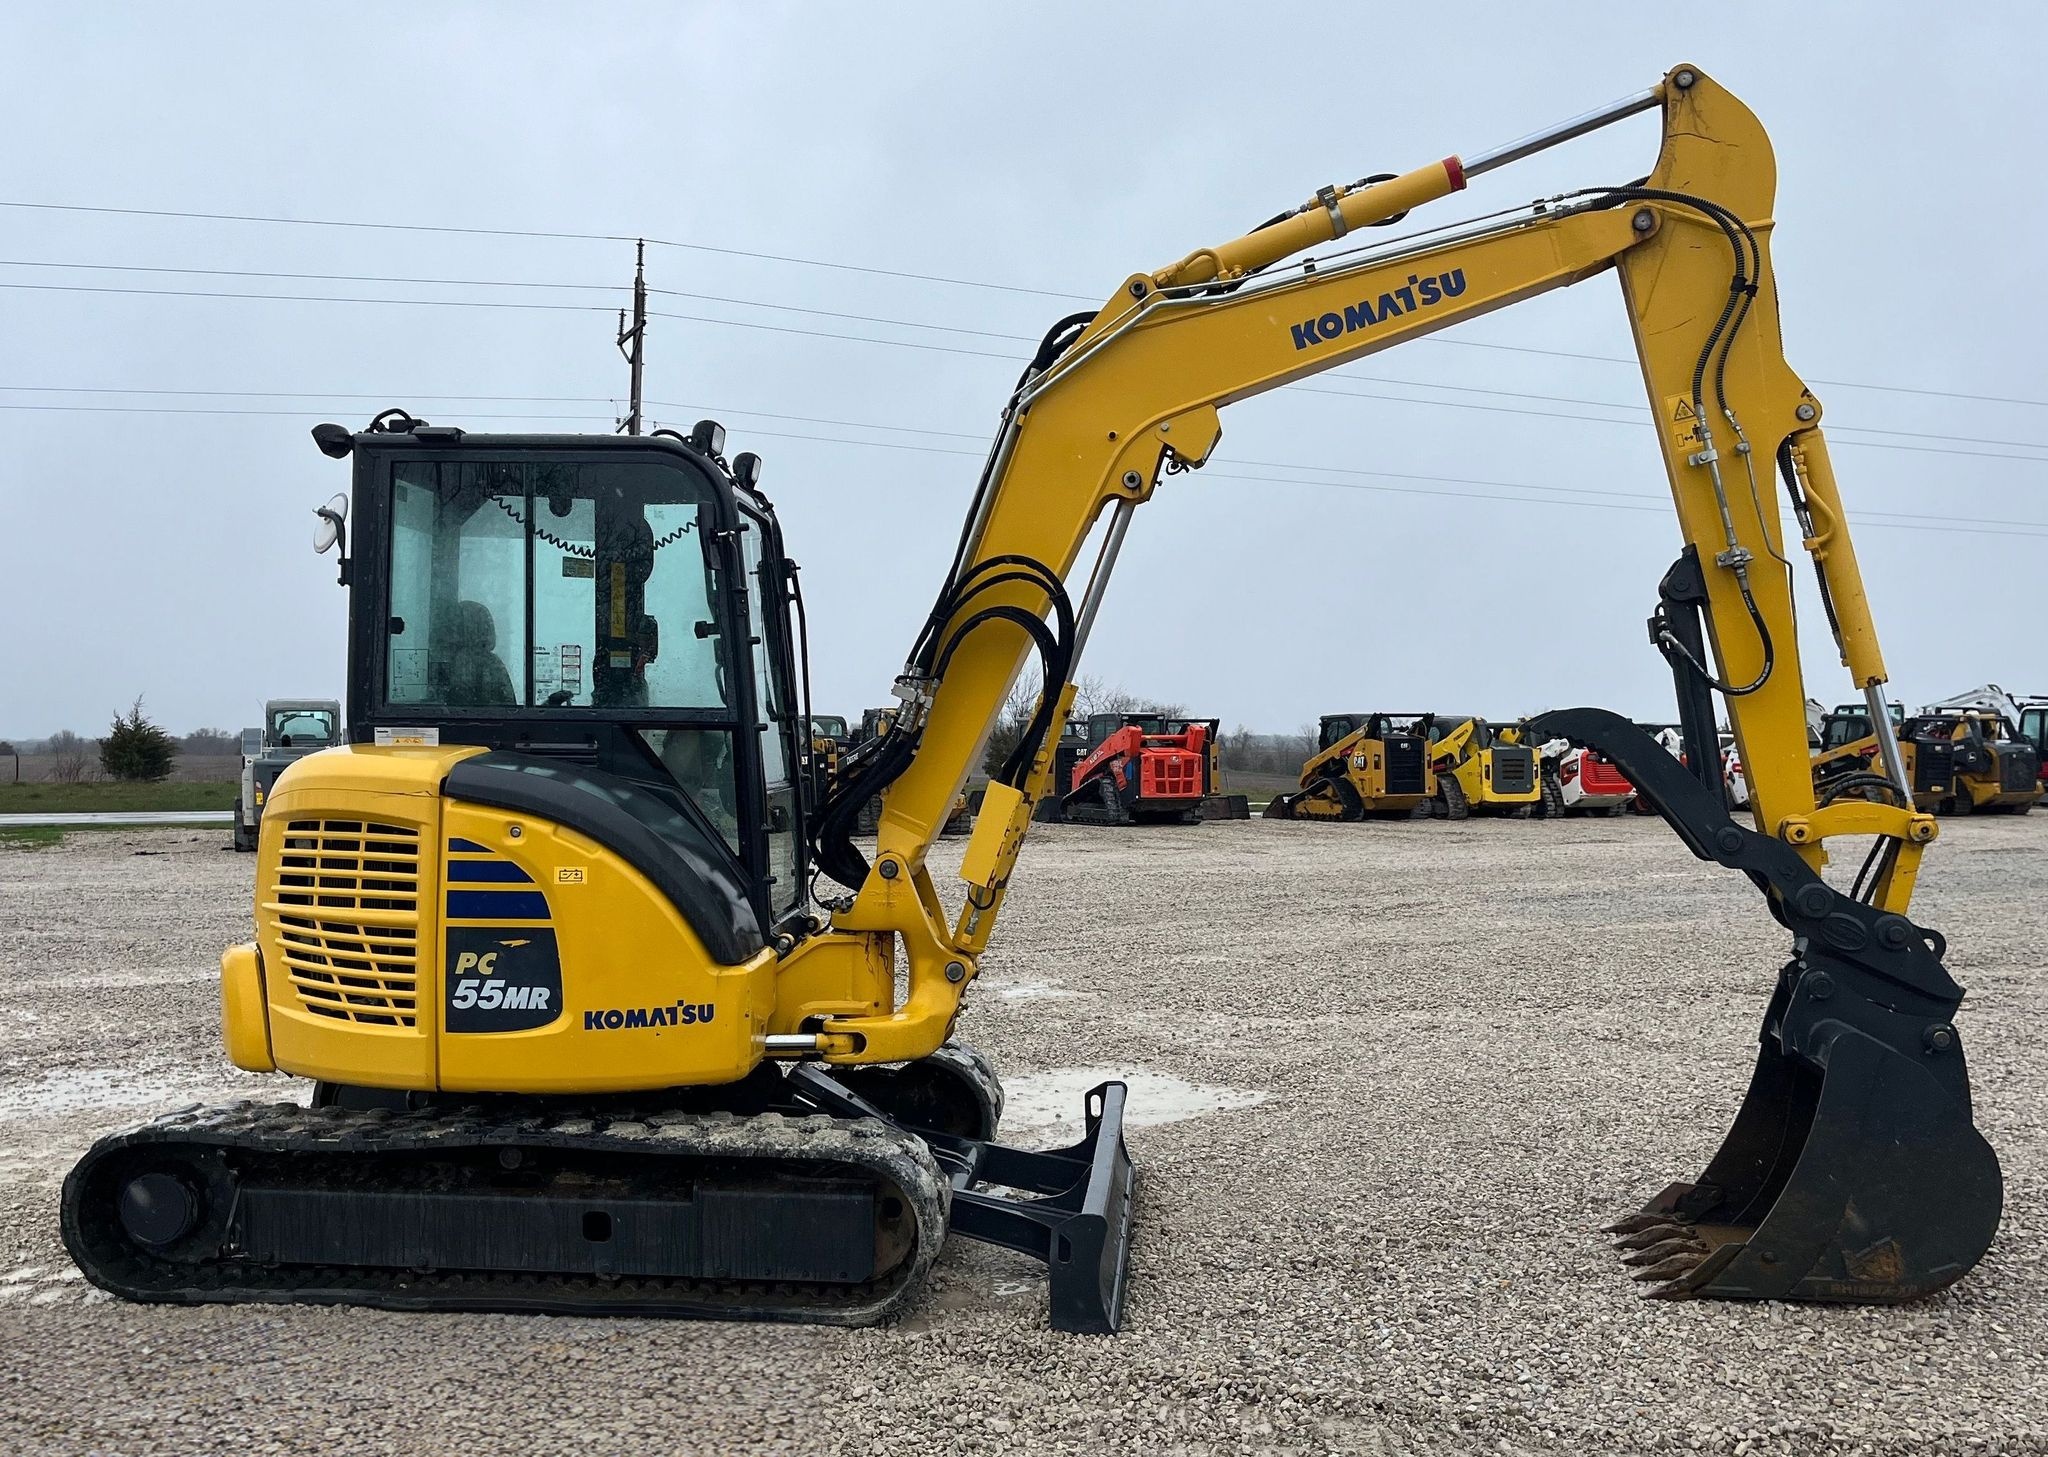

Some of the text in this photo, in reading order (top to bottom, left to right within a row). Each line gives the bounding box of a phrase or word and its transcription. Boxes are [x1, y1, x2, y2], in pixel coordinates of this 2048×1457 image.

[1290, 268, 1467, 350] KOMATSU
[1076, 748, 1087, 756] CAT
[1353, 756, 1365, 768] CAT
[454, 952, 498, 975] PC
[451, 979, 551, 1010] 55MR
[583, 999, 715, 1030] KOMATSU
